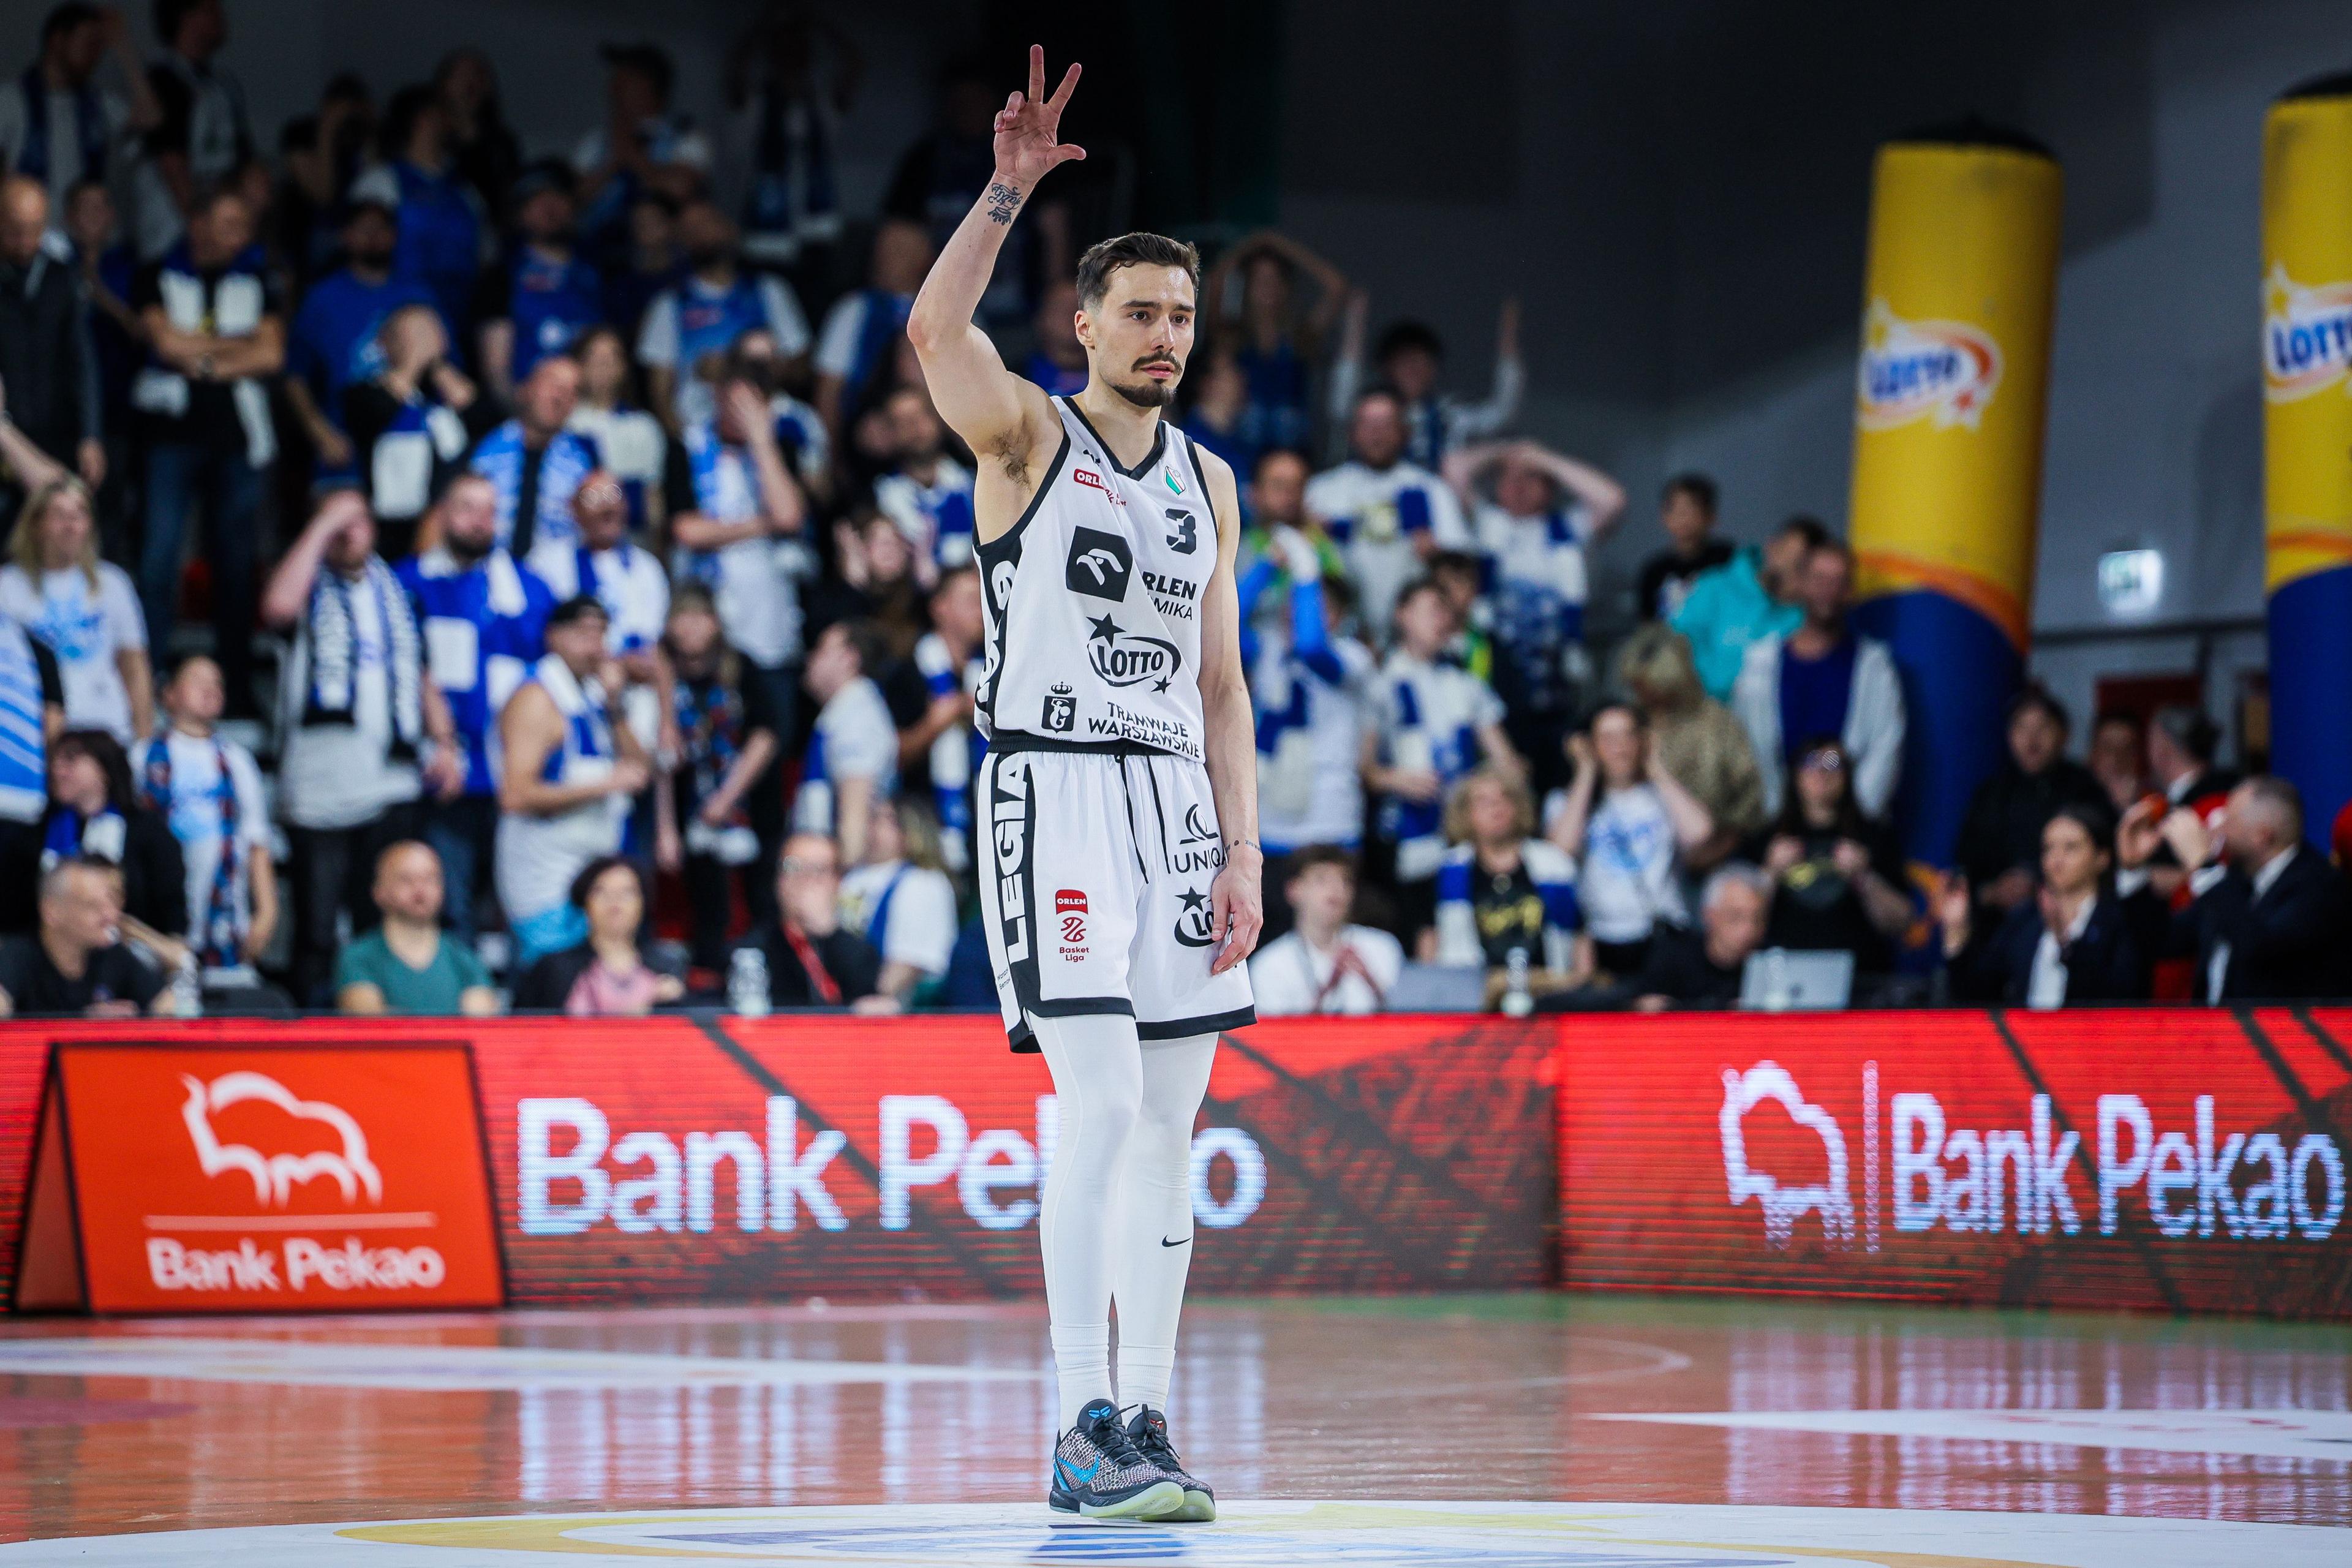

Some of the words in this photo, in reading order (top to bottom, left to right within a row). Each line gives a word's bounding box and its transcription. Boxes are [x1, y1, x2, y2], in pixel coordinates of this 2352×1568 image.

[2272, 315, 2352, 373] LOTT
[1077, 472, 1104, 489] ORL
[1165, 508, 1196, 555] 3
[1142, 571, 1197, 600] RLEN
[1149, 594, 1193, 620] MIKA
[1097, 644, 1164, 677] LOTTO
[1088, 718, 1200, 758] WARSZAWSKIE
[1107, 701, 1188, 737] TRAMWAJE
[994, 752, 1029, 964] LEGIA
[518, 1096, 849, 1234] Bank
[878, 1095, 1266, 1229] Peo
[1891, 1093, 2081, 1235] Bank
[2097, 1095, 2346, 1240] Pekao
[146, 1237, 281, 1292] Bank
[283, 1235, 447, 1292] Pekao
